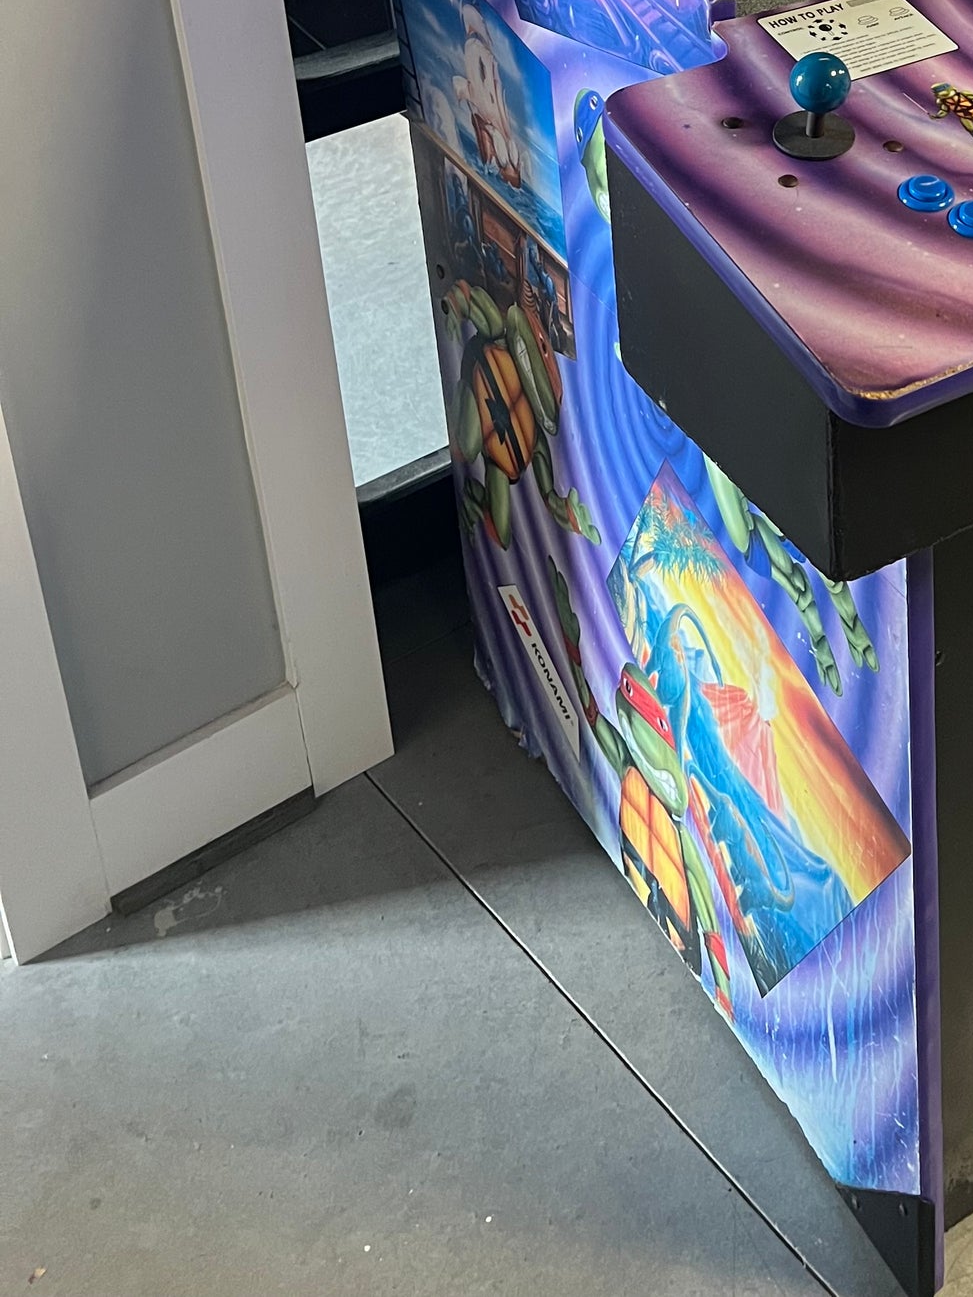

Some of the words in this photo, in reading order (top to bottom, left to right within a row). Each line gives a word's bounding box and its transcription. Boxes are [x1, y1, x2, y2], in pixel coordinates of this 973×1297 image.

[768, 11, 798, 29] HOW
[798, 9, 817, 21] TO
[816, 2, 845, 17] PLAY
[530, 643, 570, 720] KONAMI
